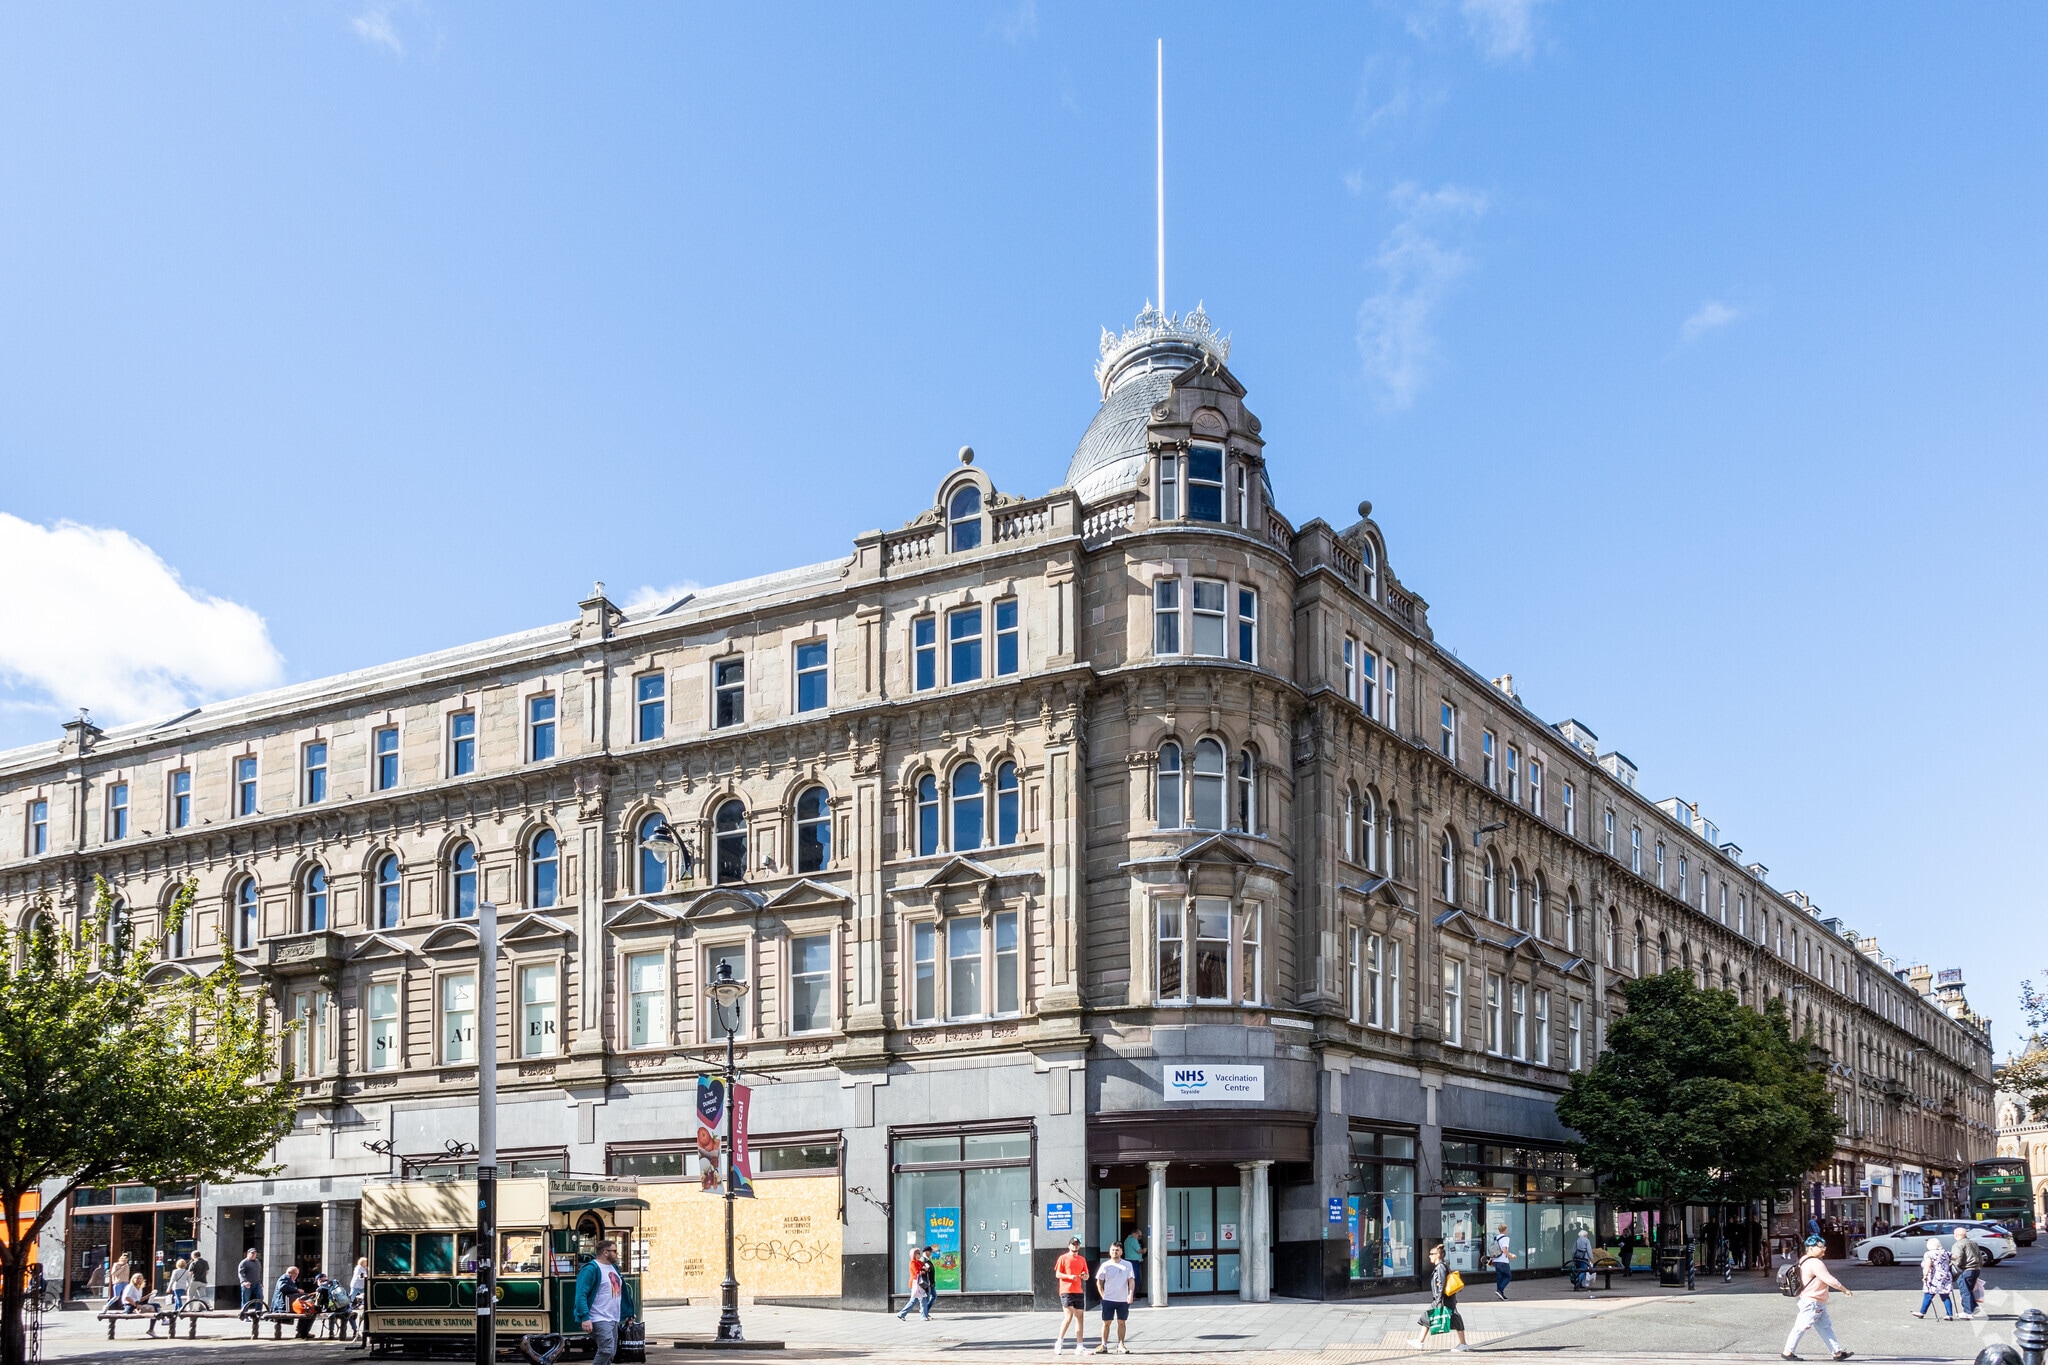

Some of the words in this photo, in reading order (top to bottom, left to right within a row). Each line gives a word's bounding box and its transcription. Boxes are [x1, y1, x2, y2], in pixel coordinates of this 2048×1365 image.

[1175, 1070, 1204, 1082] NHS
[1215, 1074, 1258, 1082] Vaccination
[550, 1181, 560, 1191] The
[562, 1181, 576, 1192] Auld
[576, 1182, 591, 1192] Tram
[930, 1216, 954, 1227] Hello
